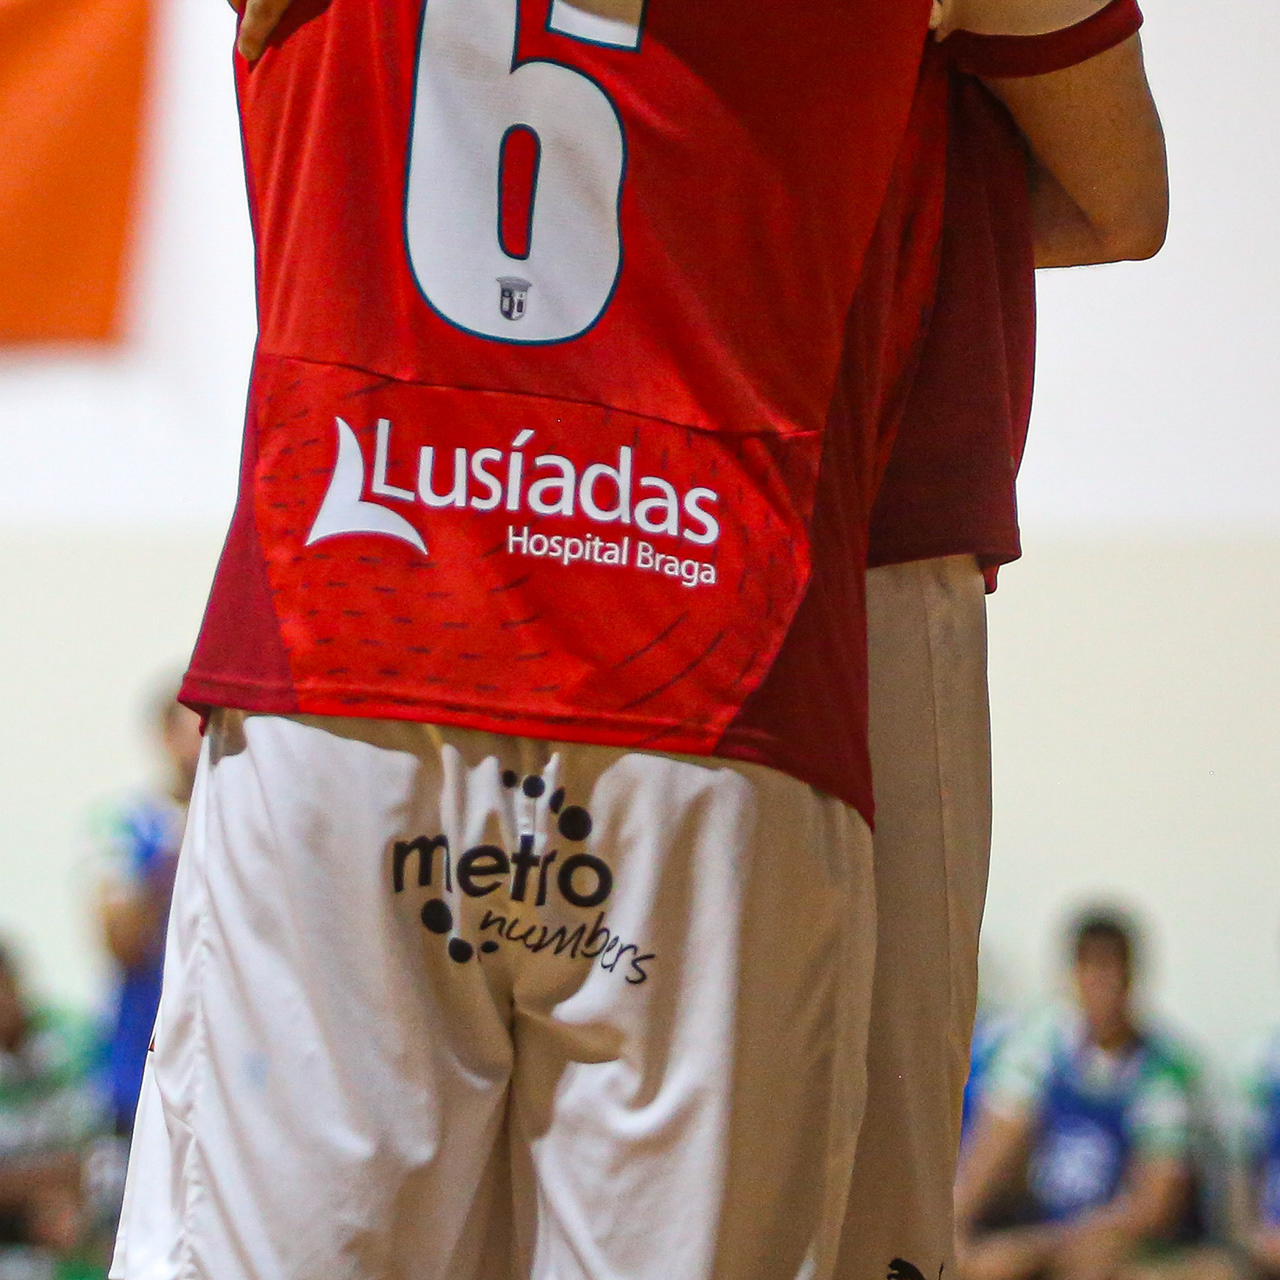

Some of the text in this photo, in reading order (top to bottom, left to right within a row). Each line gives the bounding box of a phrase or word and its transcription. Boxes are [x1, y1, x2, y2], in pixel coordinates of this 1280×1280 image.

[371, 417, 720, 546] Lusíadas
[506, 525, 717, 588] Hospital Braga
[392, 833, 613, 908] metro
[479, 910, 656, 985] numbers
